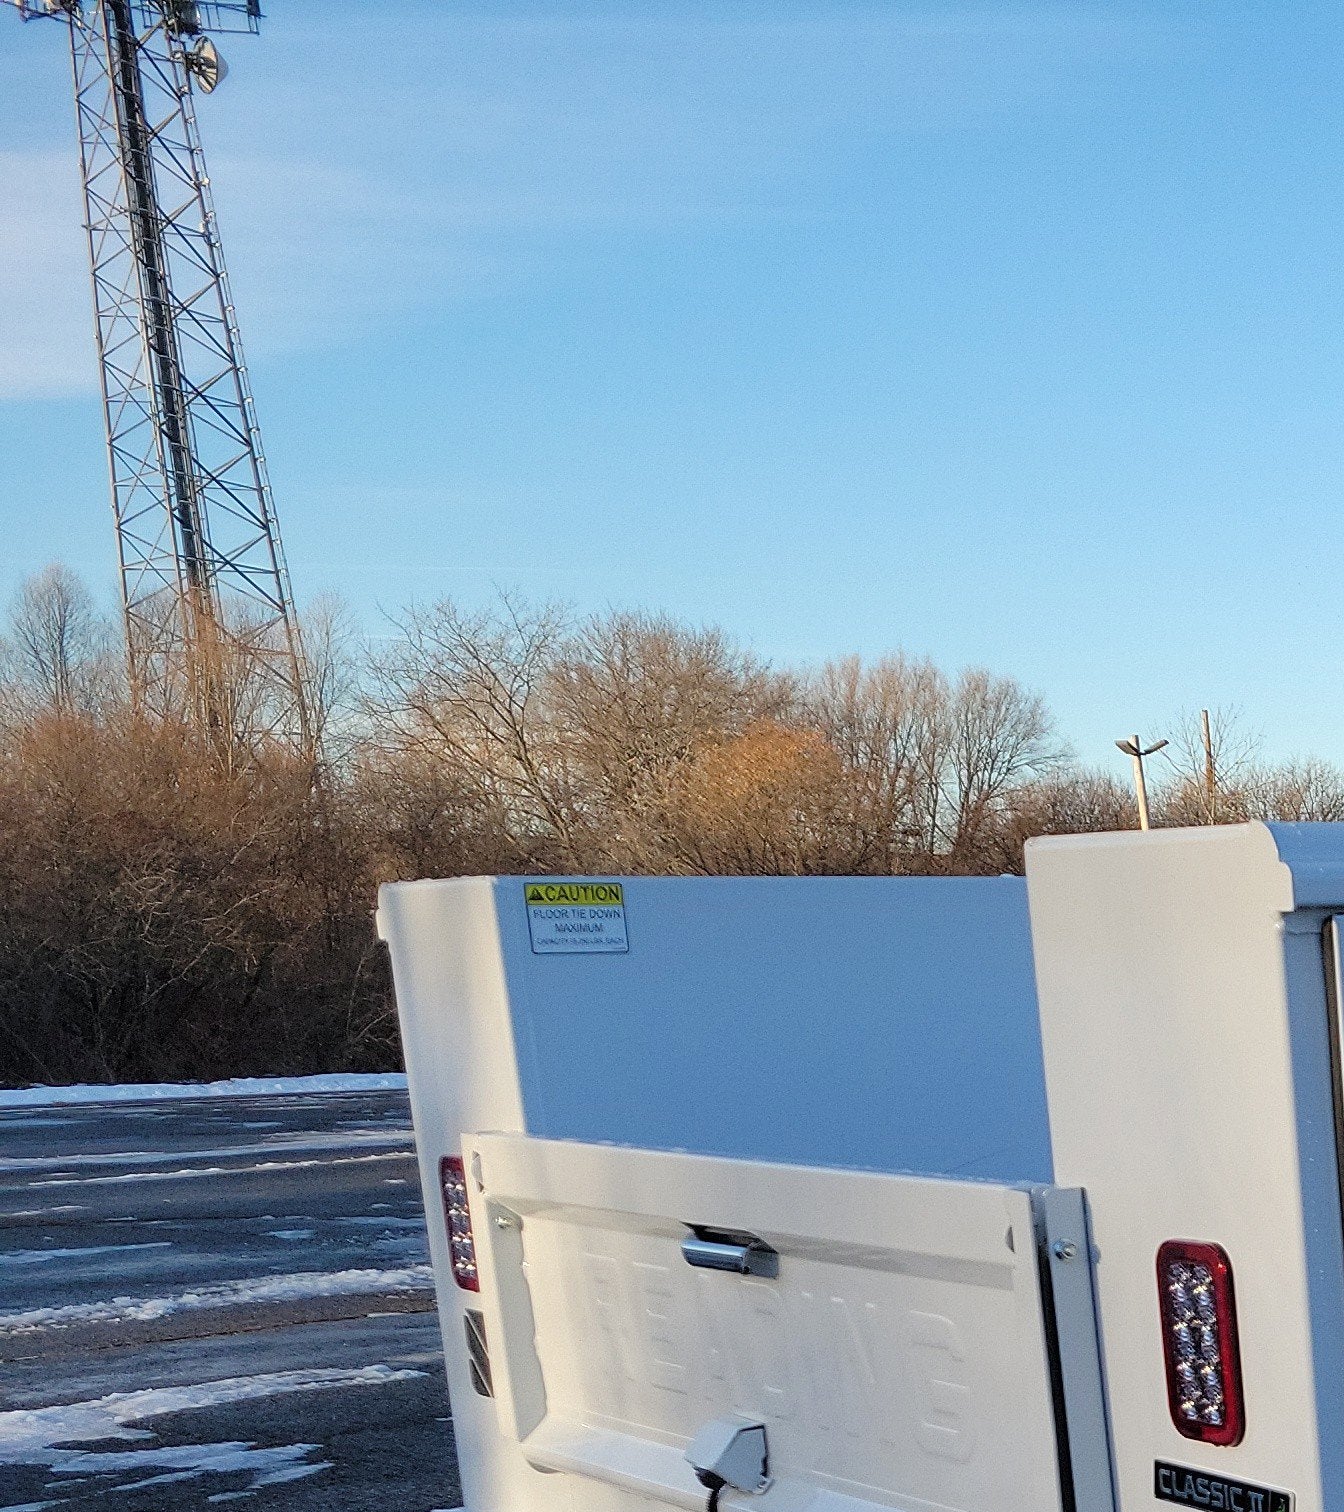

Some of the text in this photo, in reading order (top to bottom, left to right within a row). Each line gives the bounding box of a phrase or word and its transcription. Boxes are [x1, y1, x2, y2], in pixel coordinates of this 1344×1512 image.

[545, 886, 619, 902] CAUTION
[533, 909, 620, 919] FLOOR TIE DOWN
[555, 923, 604, 933] MAXIMUM
